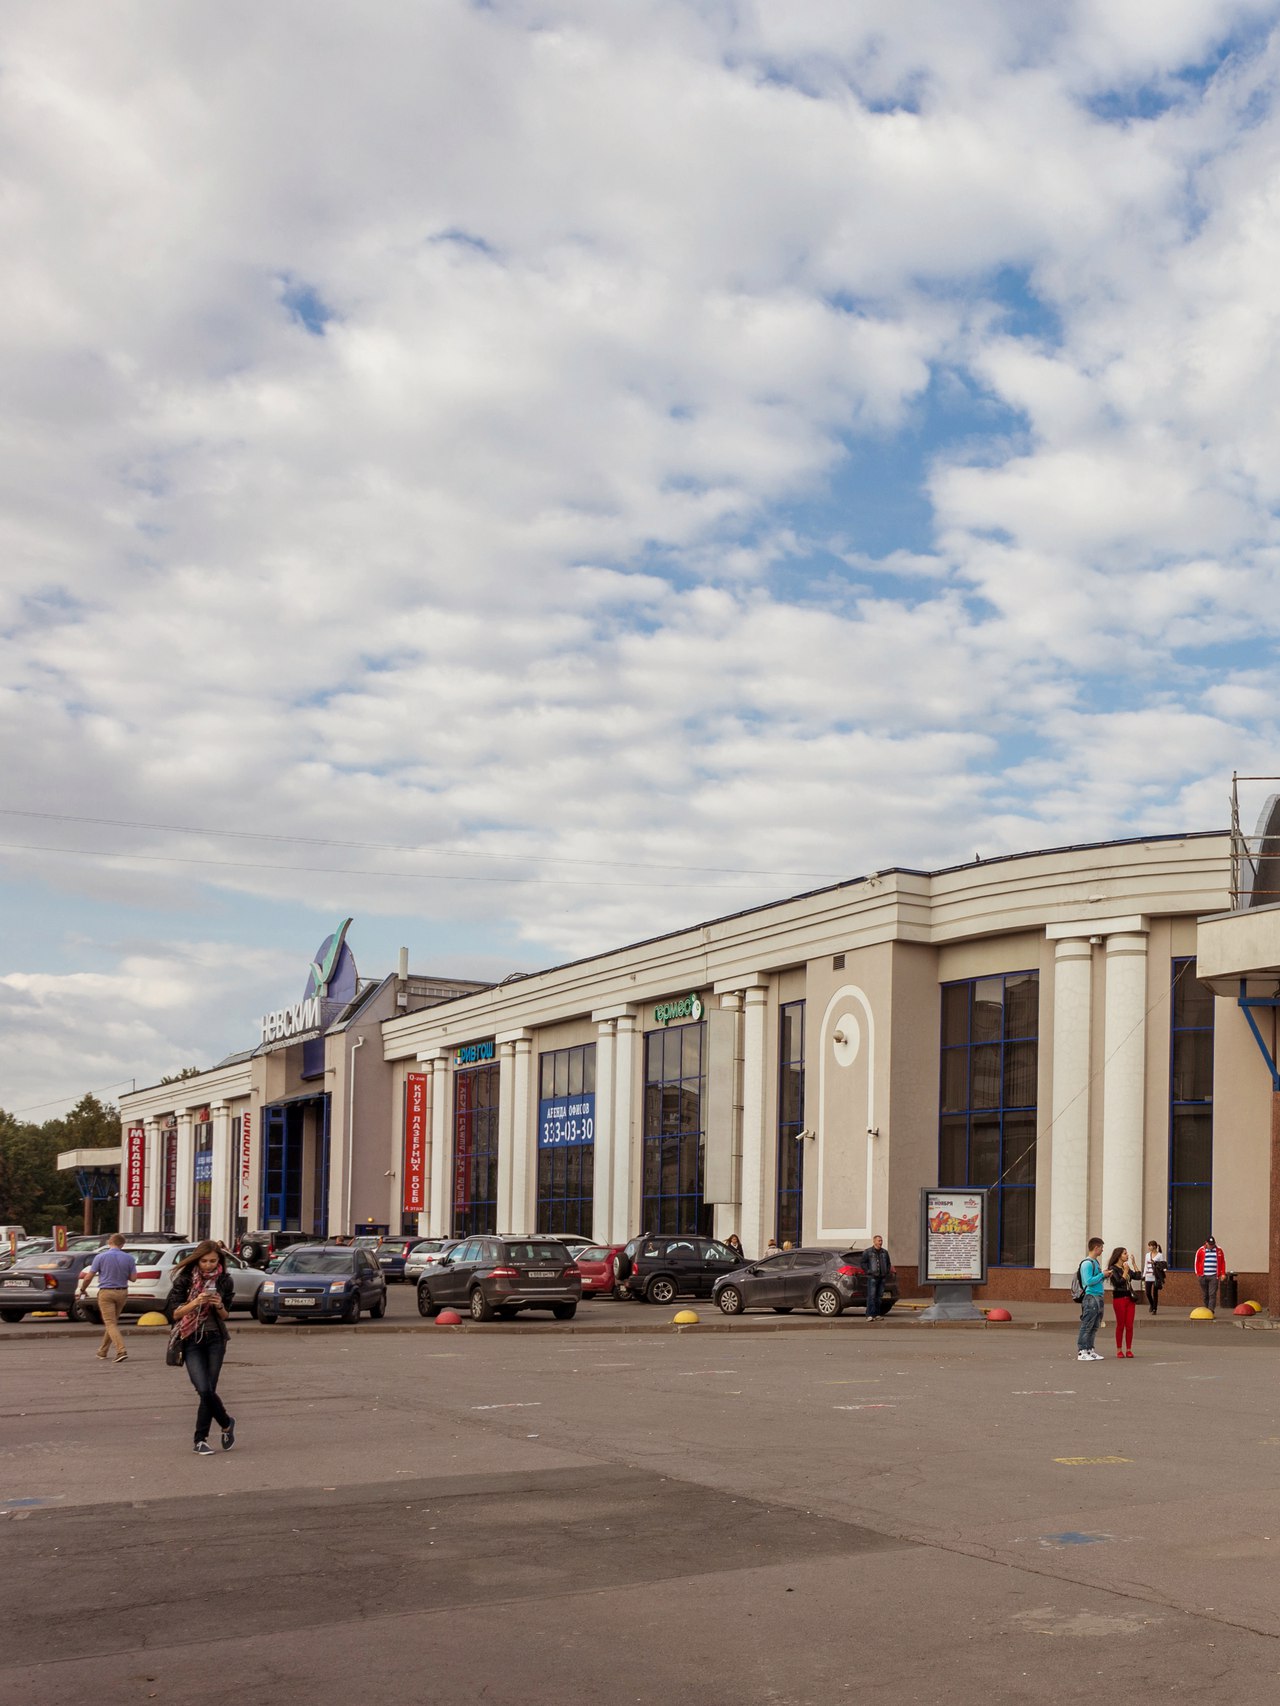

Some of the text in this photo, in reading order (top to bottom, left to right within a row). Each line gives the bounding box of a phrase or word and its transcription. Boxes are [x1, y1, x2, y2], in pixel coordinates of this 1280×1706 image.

[543, 1118, 593, 1143] 333-03-30
[547, 1103, 590, 1119] АРЕНДА ОФИСОВ
[130, 1129, 143, 1206] Макдоналдс
[410, 1084, 421, 1203] КЛУБ ЛАЗЕРНЫХ БОЕВ
